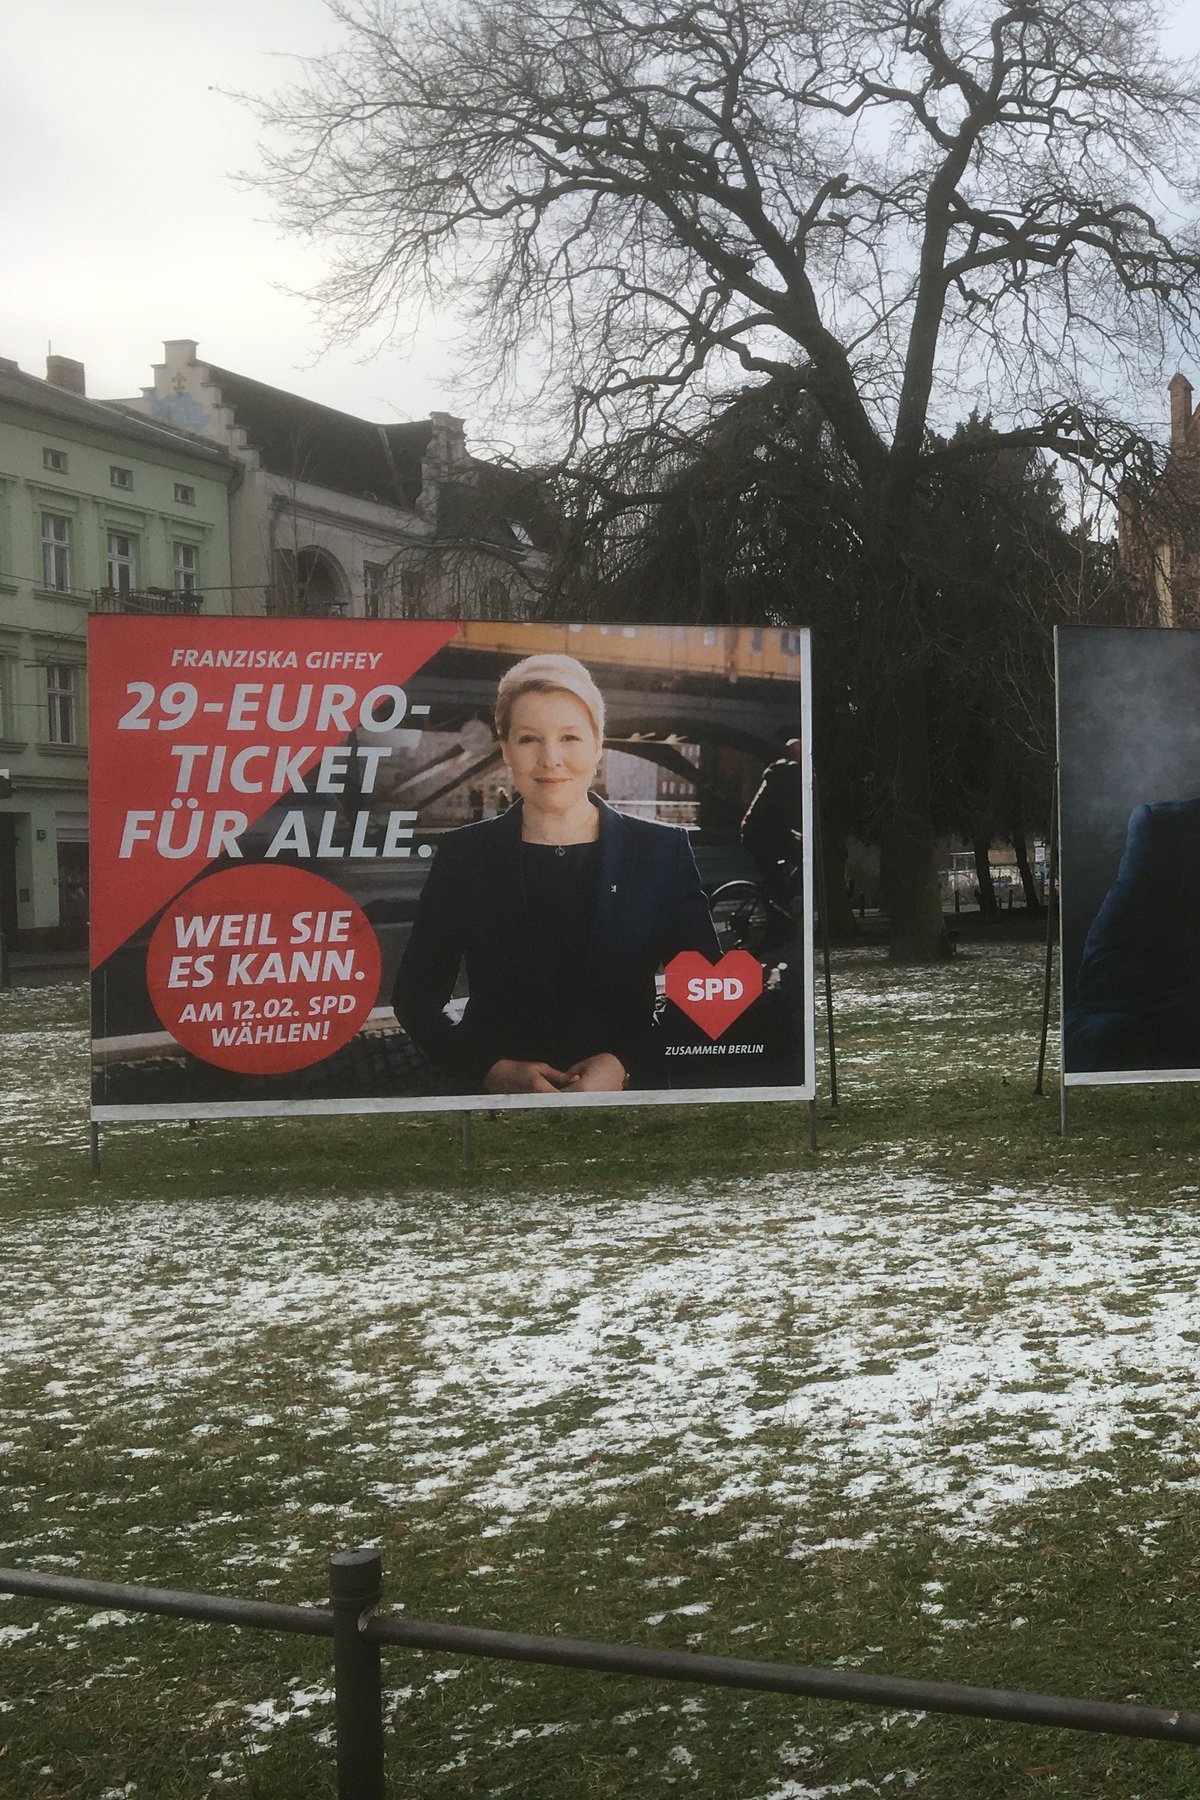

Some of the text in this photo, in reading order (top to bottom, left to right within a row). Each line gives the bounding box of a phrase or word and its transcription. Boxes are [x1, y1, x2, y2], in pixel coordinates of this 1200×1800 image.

[170, 649, 383, 670] FRANZISKA GIFFEY
[117, 681, 431, 732] 29-EURO-
[170, 745, 392, 793] TICKET
[118, 797, 432, 859] FÜR ALLE.
[174, 910, 352, 949] WEIL SIE
[167, 949, 366, 988] ES KANN.
[687, 978, 744, 1001] SPD
[178, 994, 356, 1024] AM 12.02. SPD
[211, 1020, 330, 1047] WÄHLEN!
[665, 1044, 764, 1056] ZUSAMMEN BERLIN
